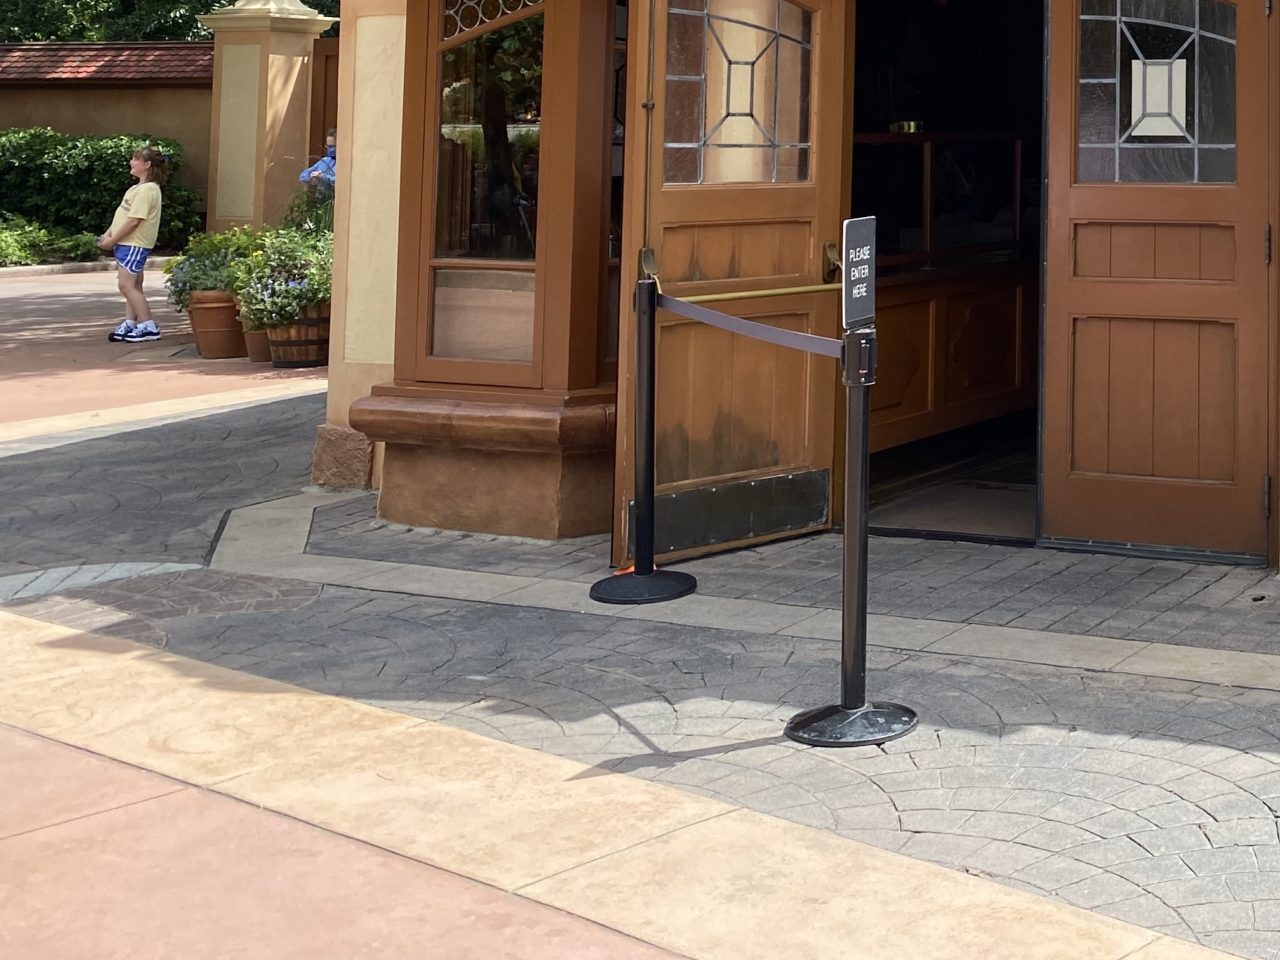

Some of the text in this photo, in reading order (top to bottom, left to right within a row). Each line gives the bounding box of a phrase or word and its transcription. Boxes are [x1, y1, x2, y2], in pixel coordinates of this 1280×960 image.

[849, 246, 871, 262] PLEASE
[850, 265, 869, 281] ENTER
[852, 283, 867, 298] HERE
